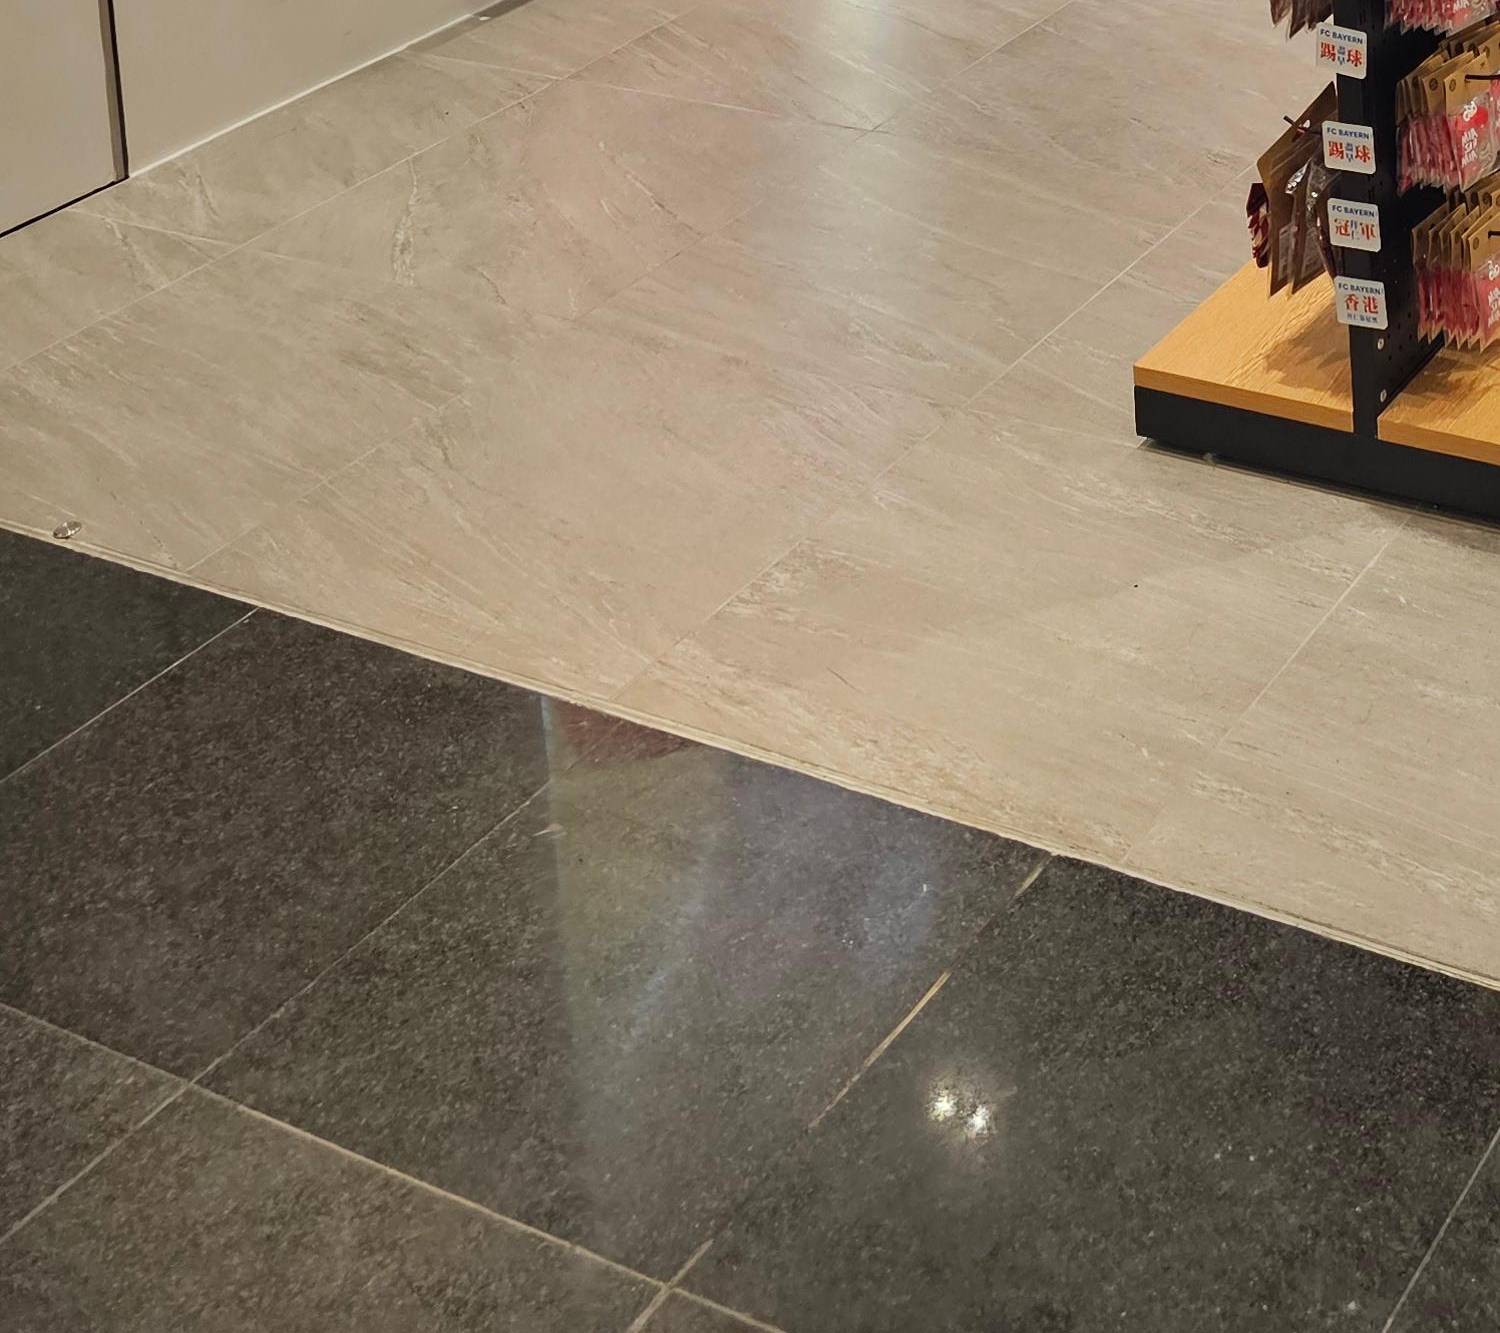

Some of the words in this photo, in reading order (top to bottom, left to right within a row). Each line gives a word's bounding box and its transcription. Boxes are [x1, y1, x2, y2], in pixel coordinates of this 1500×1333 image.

[1320, 29, 1331, 37] FC
[1332, 31, 1364, 45] BAYERN
[1326, 127, 1337, 135] FC
[1338, 128, 1370, 140] BAYERN
[1332, 205, 1343, 213] FC
[1344, 206, 1375, 218] BAYERN
[1338, 283, 1349, 291] FC
[1350, 284, 1381, 295] BAYERN
